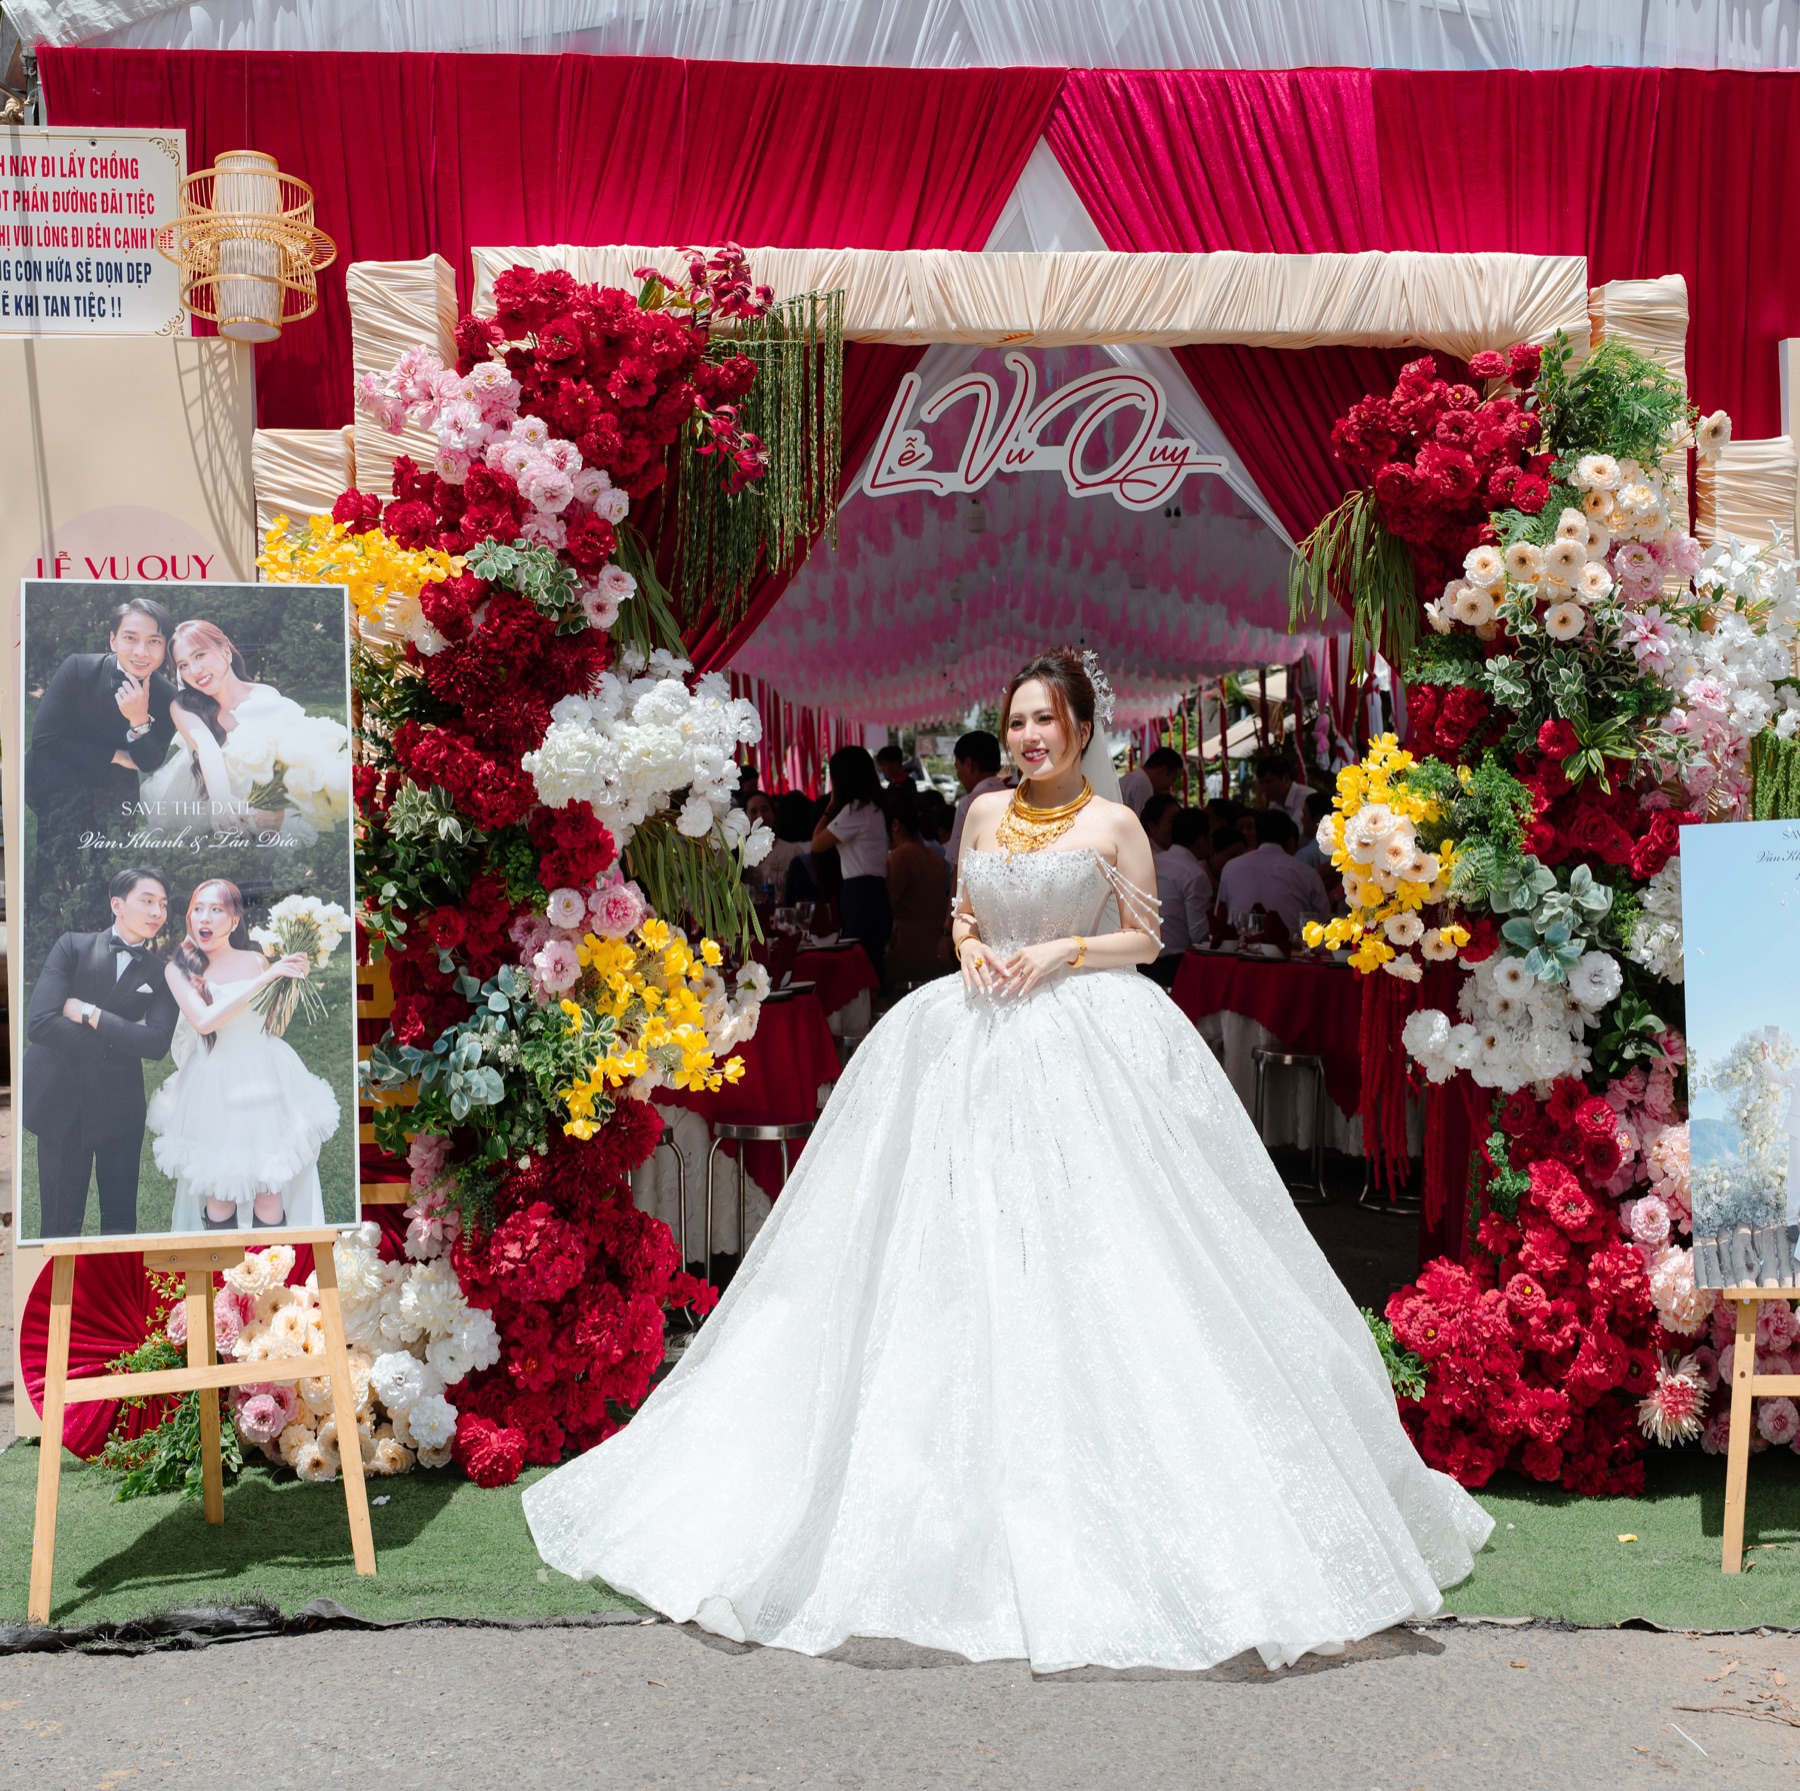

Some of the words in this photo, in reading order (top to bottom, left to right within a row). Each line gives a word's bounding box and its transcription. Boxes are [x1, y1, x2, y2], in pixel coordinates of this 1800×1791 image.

[9, 156, 37, 177] NAY
[41, 156, 56, 178] ĐI
[60, 148, 86, 179] LẤY
[90, 150, 139, 179] CHỒNG
[0, 190, 9, 211] T
[13, 184, 49, 213] PHẦN
[52, 186, 97, 213] ĐƯỜNG
[101, 188, 123, 214] ĐÃI
[126, 188, 155, 219] TIỆC
[13, 225, 33, 247] VUI
[36, 221, 68, 248] LÒNG
[71, 226, 83, 249] ĐI
[87, 223, 112, 249] BÊN
[114, 227, 147, 253] CẠNH
[0, 260, 11, 281] G
[15, 260, 42, 282] CON
[46, 256, 72, 282] HỨA
[76, 257, 92, 282] SẼ
[96, 262, 123, 288] DỌN
[127, 262, 152, 288] DẸP
[14, 295, 39, 316] KHI
[43, 295, 70, 317] TAN
[74, 291, 106, 322] TIỆC
[111, 296, 122, 318] !!
[869, 378, 944, 489] Lễ
[927, 358, 1035, 485] Vu
[1028, 374, 1222, 504] Quy
[84, 556, 129, 580] VU
[137, 554, 214, 581] QUY
[121, 801, 166, 816] SAVE
[171, 801, 206, 816] THE
[211, 801, 256, 816] DATE
[77, 831, 118, 850] Vân
[118, 825, 192, 848] Khanh
[189, 834, 208, 854] &
